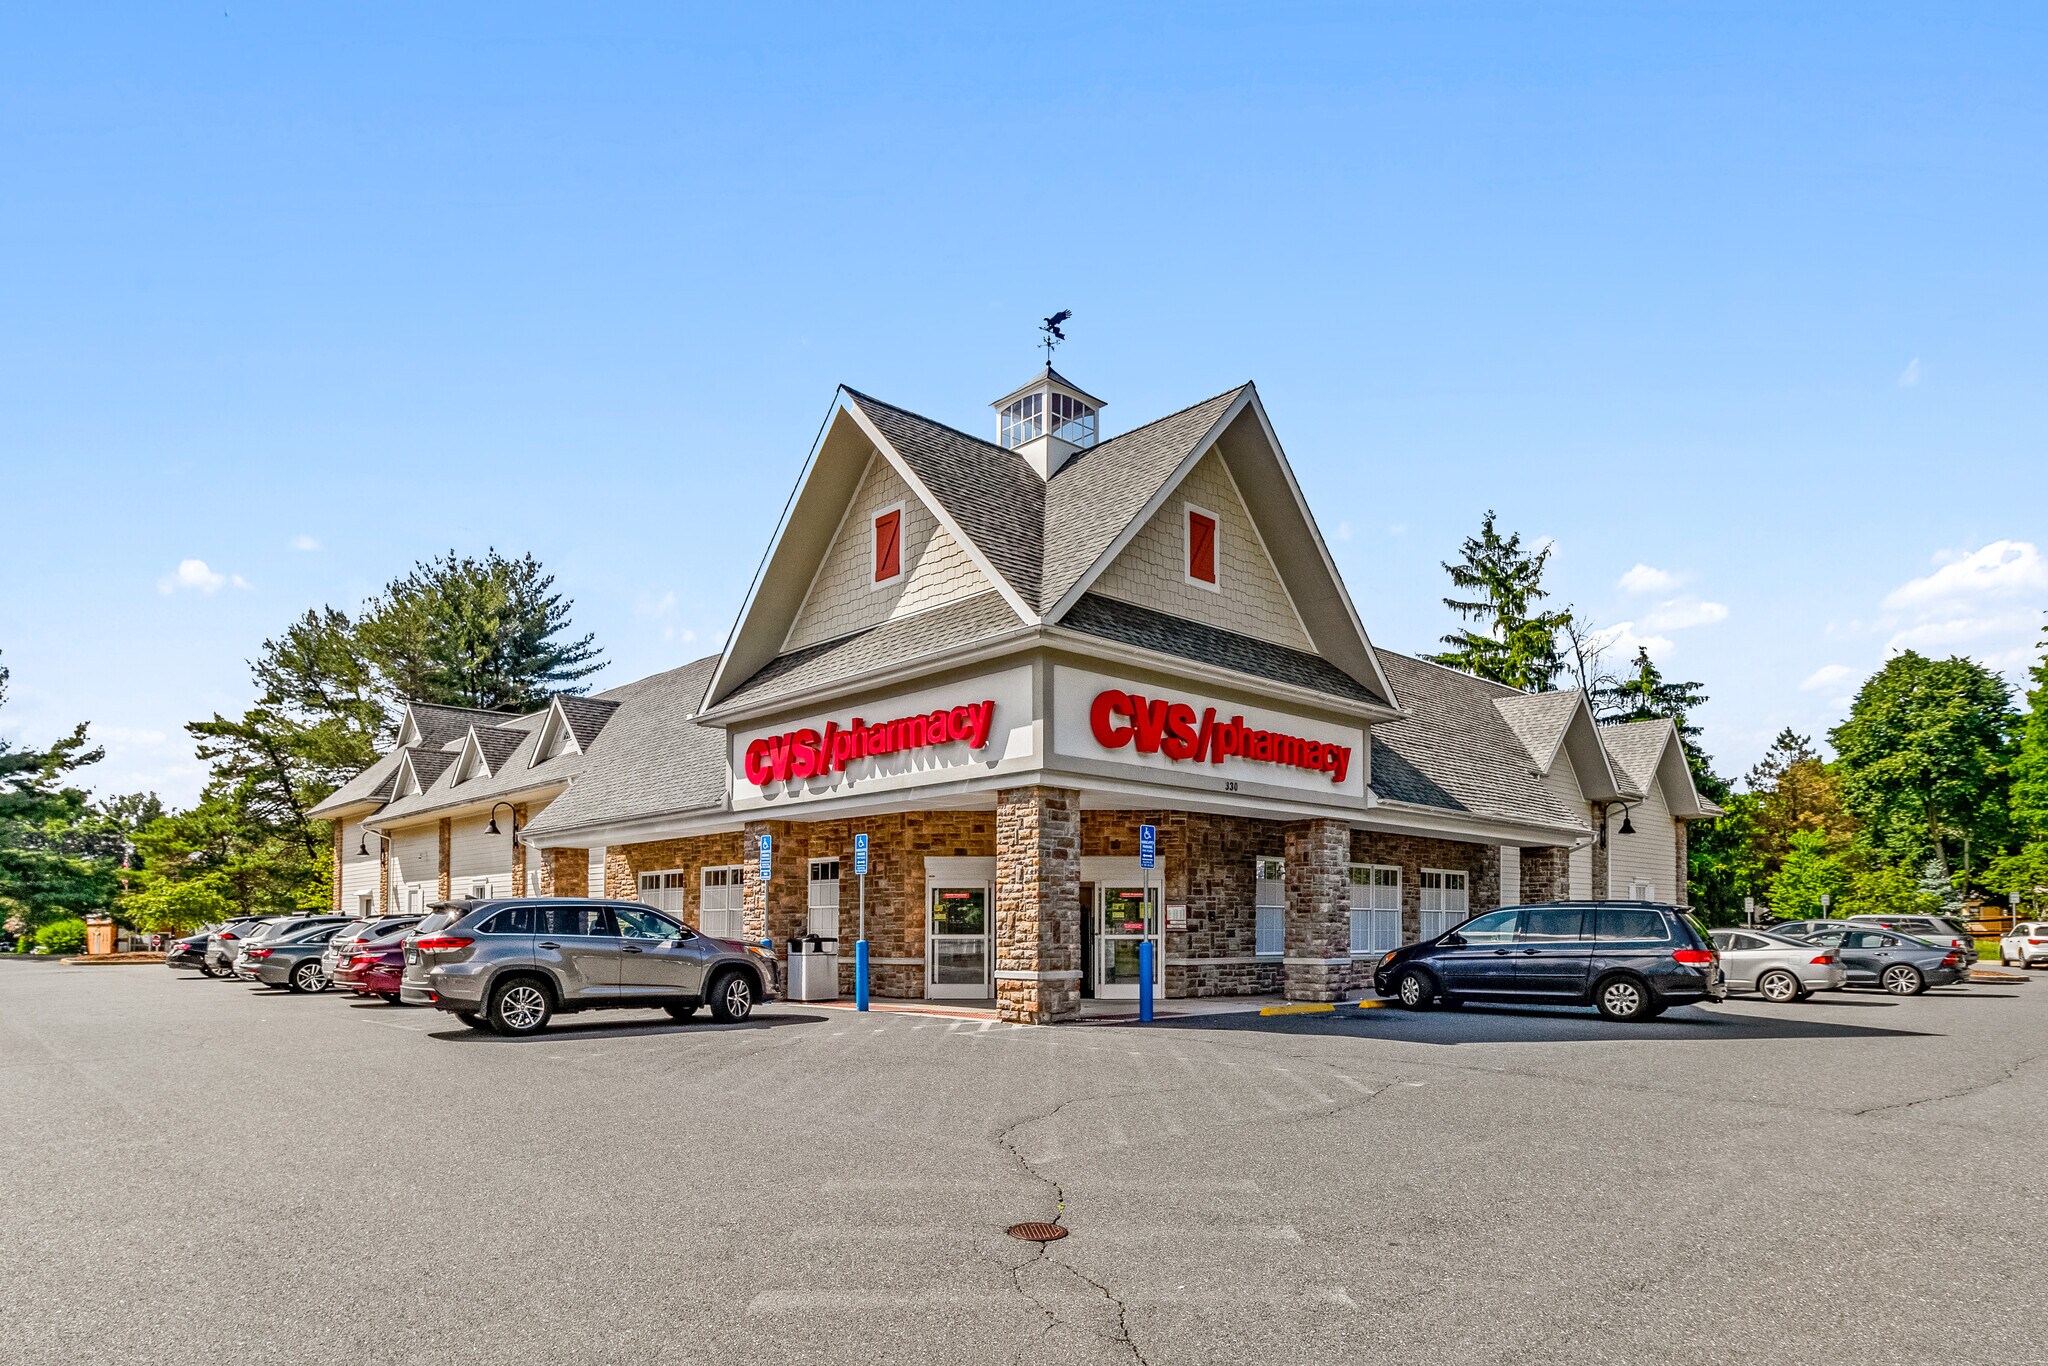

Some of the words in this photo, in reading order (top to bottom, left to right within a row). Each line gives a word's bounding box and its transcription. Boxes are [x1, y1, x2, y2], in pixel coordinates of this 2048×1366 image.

[744, 700, 996, 786] CVS/pharmacy
[1090, 689, 1352, 783] CVS/pharmacy
[1225, 781, 1238, 791] 330
